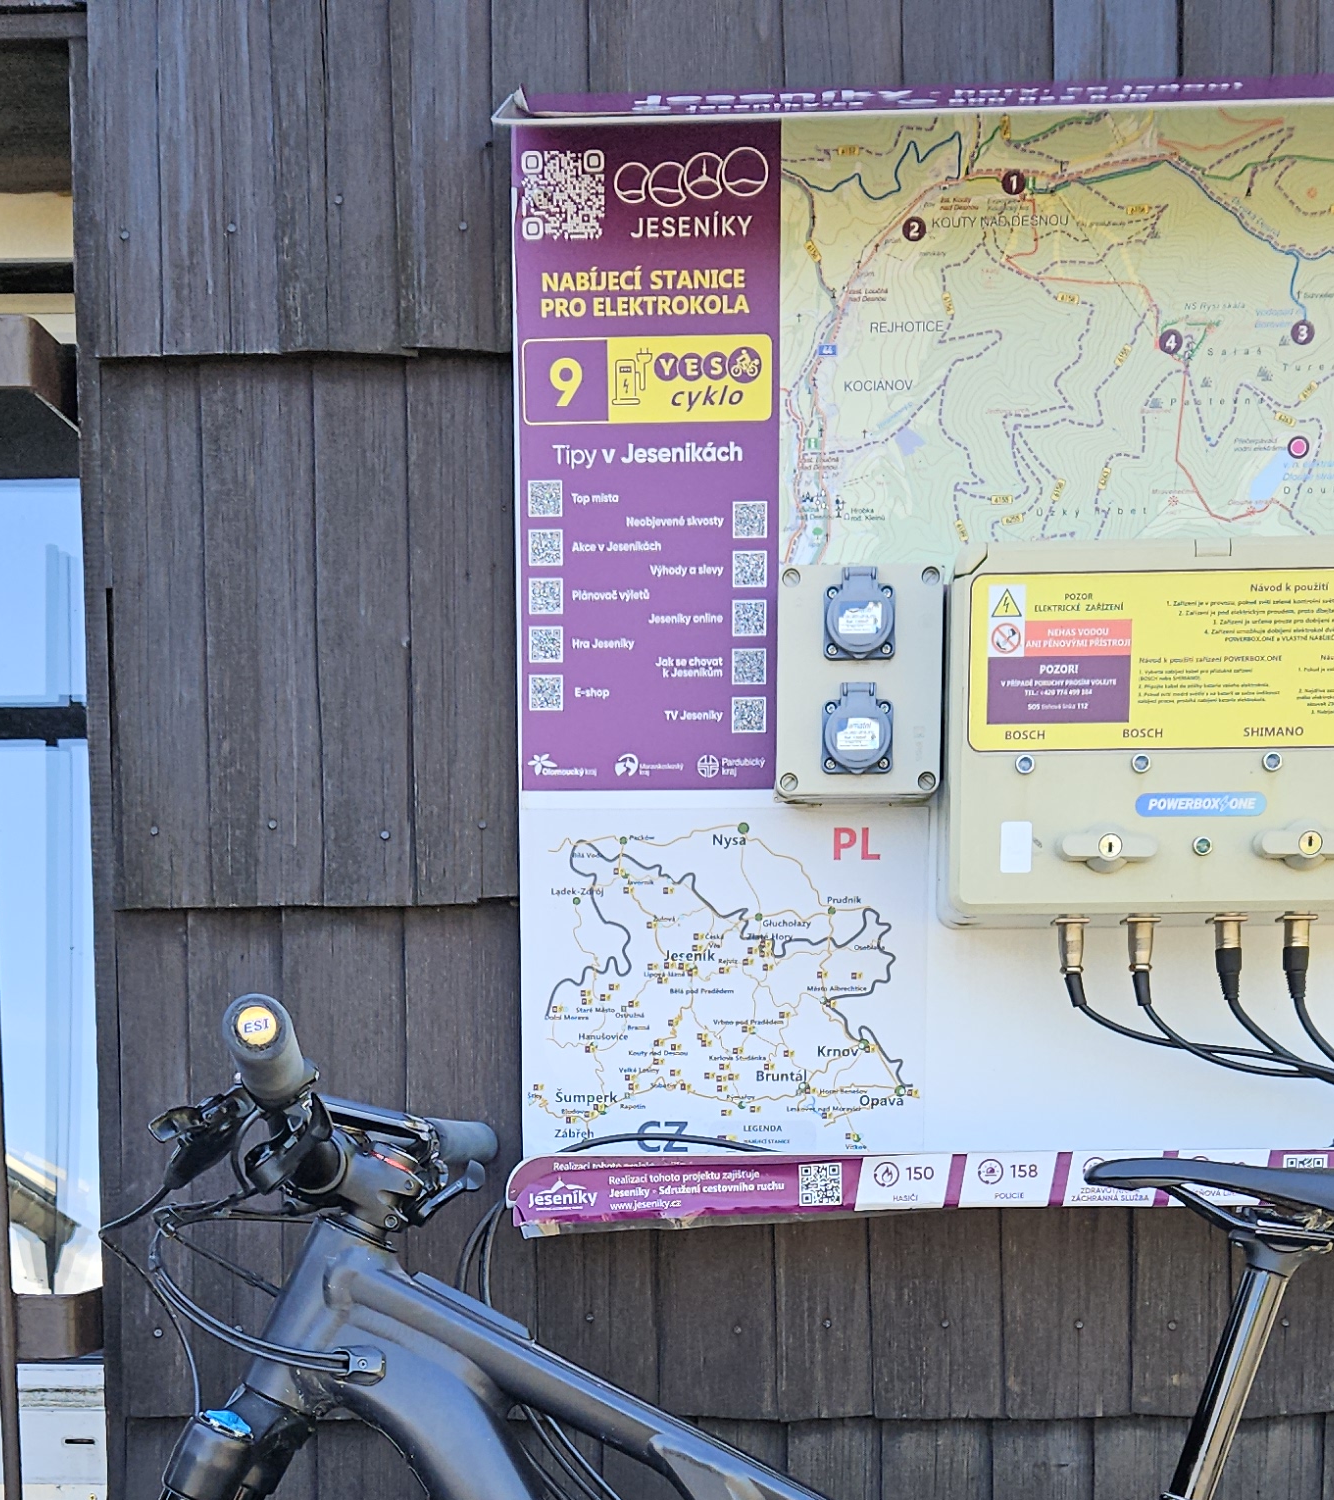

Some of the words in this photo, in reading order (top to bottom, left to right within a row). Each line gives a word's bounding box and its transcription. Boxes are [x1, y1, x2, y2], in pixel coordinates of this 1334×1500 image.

[1009, 174, 1018, 190] 1
[630, 211, 753, 238] JESENÍKY
[931, 216, 977, 229] KOUTY
[980, 215, 1007, 228] NAD
[1012, 214, 1069, 228] DESNOU
[908, 221, 920, 237] 2
[541, 266, 642, 292] NABÍJECÍ
[650, 268, 745, 291] STANICE
[541, 298, 587, 318] PRO
[593, 294, 750, 317] ELEKTROKOLA
[869, 320, 945, 333] REJHOTICE
[1297, 325, 1309, 341] 3
[1164, 334, 1178, 350] 4
[658, 356, 723, 377] YES
[549, 357, 583, 407] 9
[843, 377, 914, 392] KOCIÁNOV
[671, 385, 744, 412] cyklo
[552, 444, 598, 469] Tipy
[602, 448, 616, 464] v
[621, 441, 743, 464] Jeseníkách
[571, 493, 590, 505] Top
[591, 492, 619, 504] místa
[626, 516, 685, 528] Neobjevené
[687, 516, 724, 528] skvosty
[571, 541, 596, 553] Akce
[597, 544, 605, 553] v
[606, 541, 662, 553] Jeseníkách
[650, 564, 688, 577] Výhody
[689, 567, 696, 575] a
[698, 564, 724, 577] slevy
[1250, 582, 1282, 592] Návod
[1285, 582, 1291, 591] k
[1294, 582, 1329, 594] použití
[571, 589, 618, 601] Plánovač
[619, 588, 650, 602] výletů
[1064, 592, 1093, 601] POZOR
[1034, 603, 1081, 612] ELEKTRICKÉ
[1085, 602, 1124, 612] ZAŘÍZENÍ
[648, 612, 691, 626] Jeseníky
[693, 613, 724, 624] online
[1047, 628, 1076, 637] NEHAS
[1078, 627, 1109, 636] VODOU
[572, 639, 590, 650] Hra
[592, 638, 635, 651] Jeseníky
[1025, 640, 1041, 648] ANI
[1043, 639, 1088, 648] PĚNOVÝMI
[1089, 638, 1131, 647] PŘÍSTROJI
[655, 656, 674, 667] Jak
[676, 658, 687, 667] se
[688, 656, 723, 667] chovat
[662, 668, 669, 678] k
[670, 667, 723, 679] Jeseníkům
[1039, 663, 1079, 675] POZOR!
[1006, 679, 1033, 688] PŘÍPADĚ
[1091, 678, 1117, 686] VOLEJTE
[574, 687, 610, 700] E-shop
[1027, 702, 1040, 710] SOS
[1077, 702, 1088, 710] 112
[664, 710, 678, 720] TV
[680, 709, 723, 722] Jeseníky
[1005, 729, 1046, 741] BOSCH
[1122, 727, 1163, 739] BOSCH
[1243, 725, 1304, 738] SHIMANO
[721, 757, 766, 769] Pardubický
[542, 767, 584, 778] Olomoucký
[721, 767, 737, 778] kraj
[1147, 796, 1219, 811] POWERBOX
[1229, 796, 1256, 810] ONE
[712, 834, 747, 850] Nysa
[833, 827, 881, 861] PL
[551, 888, 604, 897] Lądek-Zdrój
[827, 895, 862, 905] Prudnik
[762, 919, 812, 930] Głuchołazy
[664, 950, 716, 962] Jeseník
[686, 988, 698, 996] pod
[700, 987, 734, 995] Pradědem
[576, 1006, 593, 1014] Staré
[595, 1006, 616, 1014] Město
[243, 1017, 270, 1035] ESI
[578, 1033, 629, 1041] Hanušovice
[817, 1045, 859, 1057] Krnov
[756, 1069, 807, 1082] Bruntál
[555, 1088, 618, 1107] Šumperk
[859, 1094, 905, 1109] Opava
[554, 1128, 595, 1139] Zábřeh
[743, 1124, 783, 1132] LEGENDA
[637, 1120, 689, 1153] CZ
[608, 1174, 647, 1186] Realizaci
[649, 1173, 681, 1184] tohoto
[682, 1171, 721, 1186] projektu
[722, 1169, 760, 1182] zajišťuje
[905, 1166, 934, 1182] 150
[1010, 1164, 1038, 1179] 158
[609, 1185, 650, 1198] Jeseníky
[658, 1183, 701, 1196] Sdružení
[702, 1181, 754, 1193] cestovního
[756, 1180, 785, 1192] ruchu
[994, 1191, 1025, 1200] POLICIE
[528, 1189, 598, 1209] Jeseníky
[893, 1191, 919, 1203] HASIČI
[1071, 1192, 1118, 1203] ZÁCHRANNÁ
[1120, 1191, 1150, 1202] SLUŽBA
[609, 1199, 682, 1212] www.jeseniky.cz
